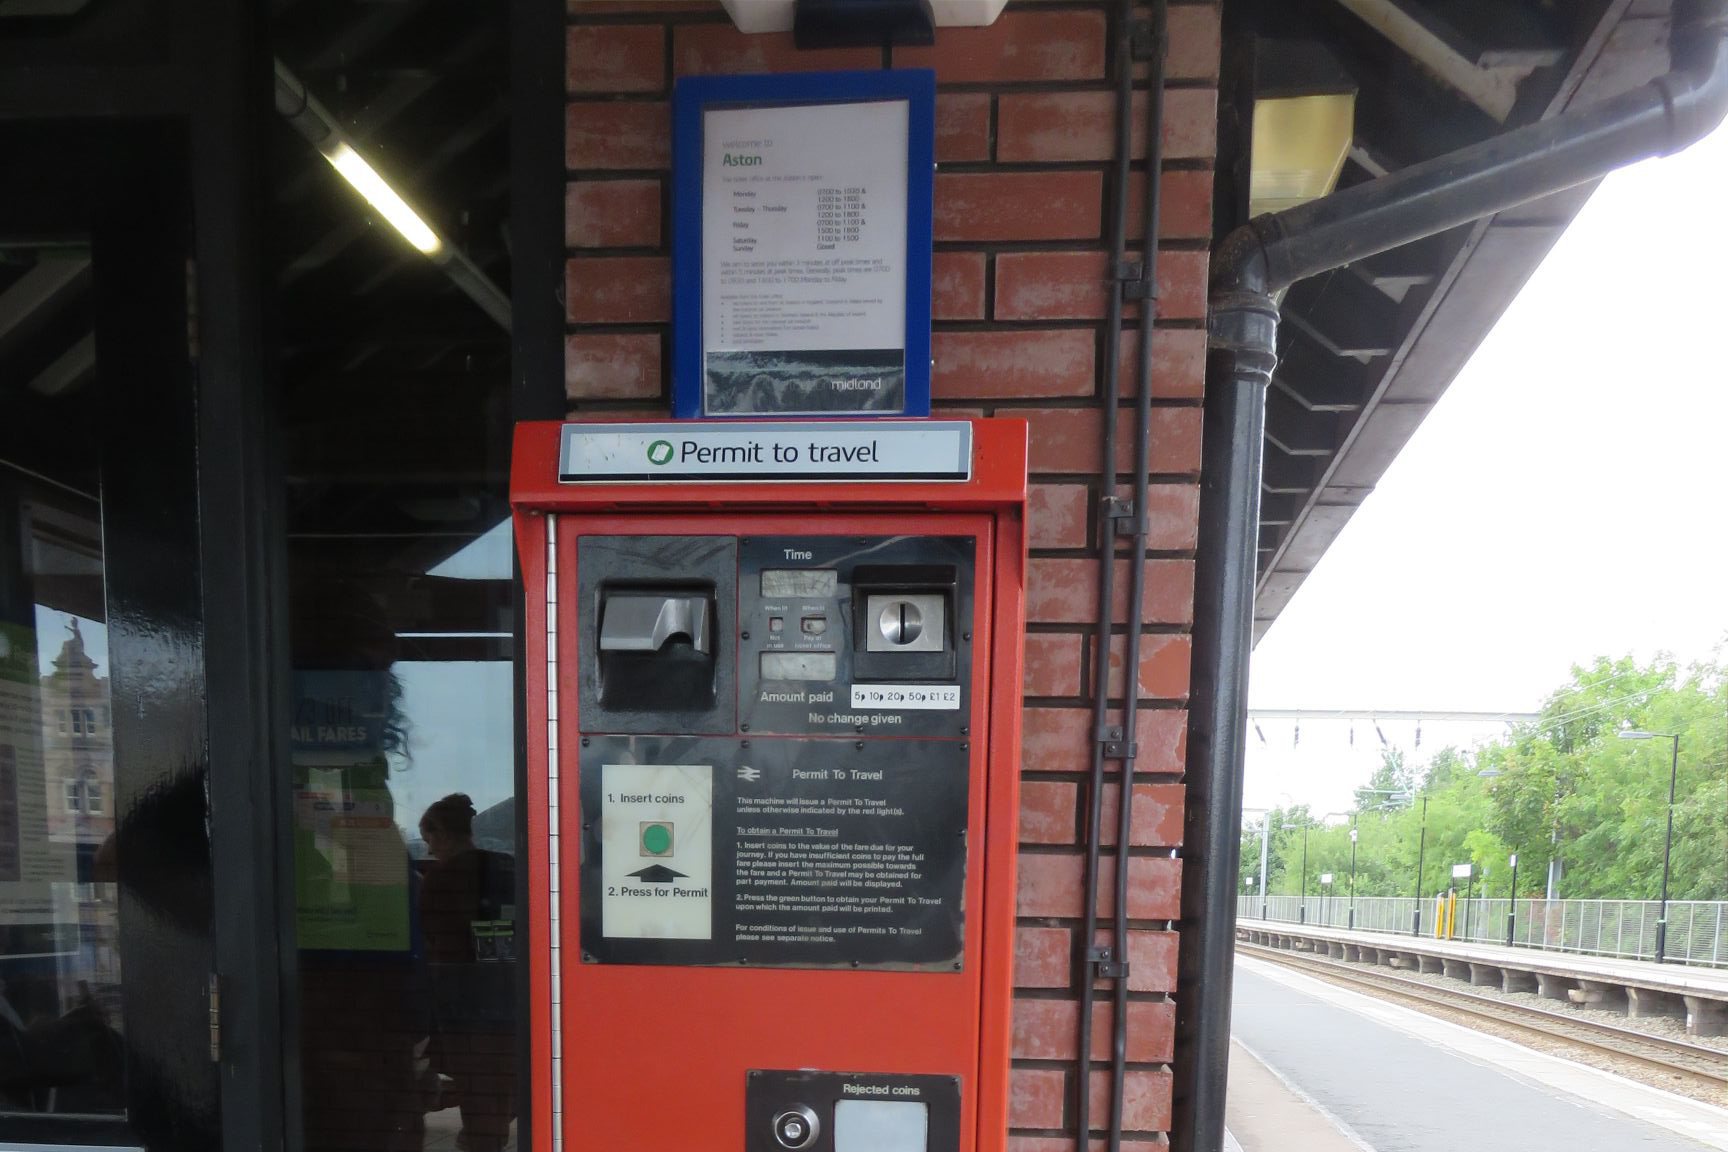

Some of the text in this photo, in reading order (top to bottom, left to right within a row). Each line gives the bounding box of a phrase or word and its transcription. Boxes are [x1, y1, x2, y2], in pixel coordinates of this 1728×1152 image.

[723, 153, 762, 167] Aston
[832, 378, 881, 391] midland
[681, 440, 879, 464] Permit to travel
[784, 549, 812, 561] Time
[761, 691, 833, 705] Amount paid
[854, 691, 955, 702] 5p 10p 20p 50p £1 £2
[808, 714, 902, 727] No change given
[317, 725, 368, 741] FARES
[792, 769, 883, 780] Permit To Travel
[608, 793, 685, 804] 1. Insert coins
[877, 808, 904, 816] light(s).
[755, 879, 788, 887] payment.
[608, 887, 708, 898] 2. Press for Permit
[843, 1084, 920, 1096] Rejected coins
